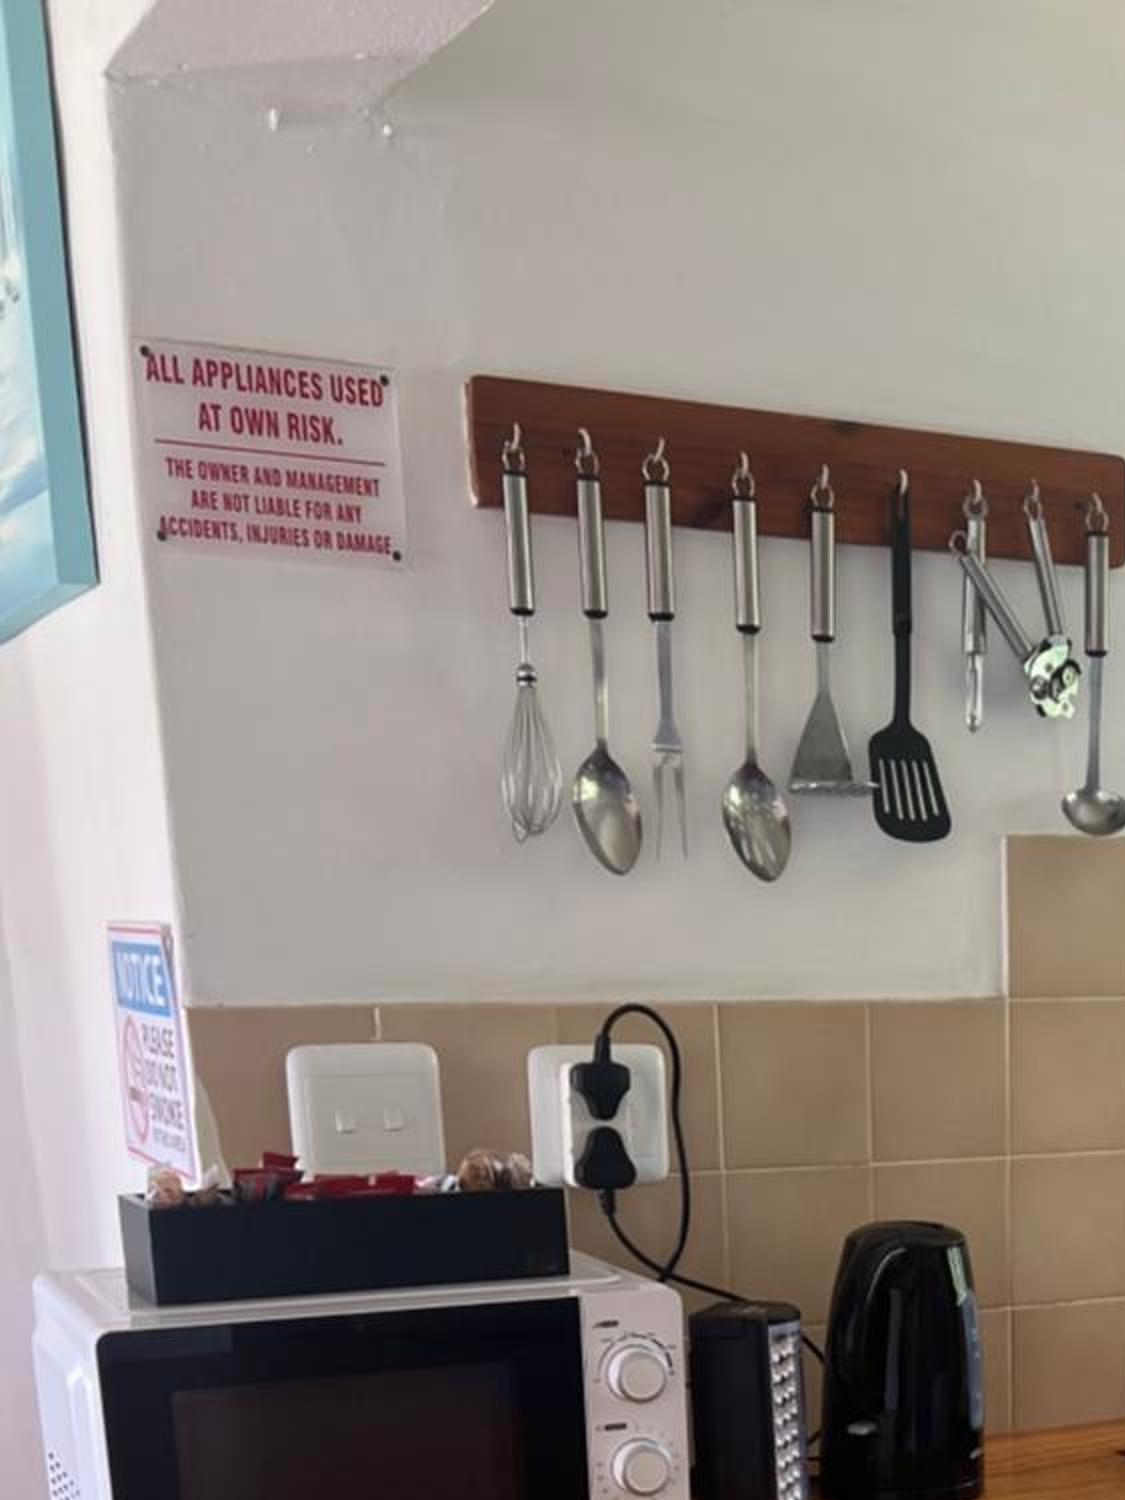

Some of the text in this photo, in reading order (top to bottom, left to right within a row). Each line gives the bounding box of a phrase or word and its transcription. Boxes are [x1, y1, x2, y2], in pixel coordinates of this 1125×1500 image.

[146, 353, 383, 407] ALL APPLIANCES USED
[199, 402, 343, 446] AT OWN RISK.
[165, 457, 379, 496] THE OWNER AND MANAGEMENT
[191, 490, 362, 524] ARE NOT LIABLE FOR ANY
[160, 516, 391, 555] ACCIDENTS, INJURIES OR DAMAGE
[114, 949, 166, 1008] NOTICE
[141, 1022, 176, 1058] PLEASE
[149, 1092, 184, 1130] SMOKE
